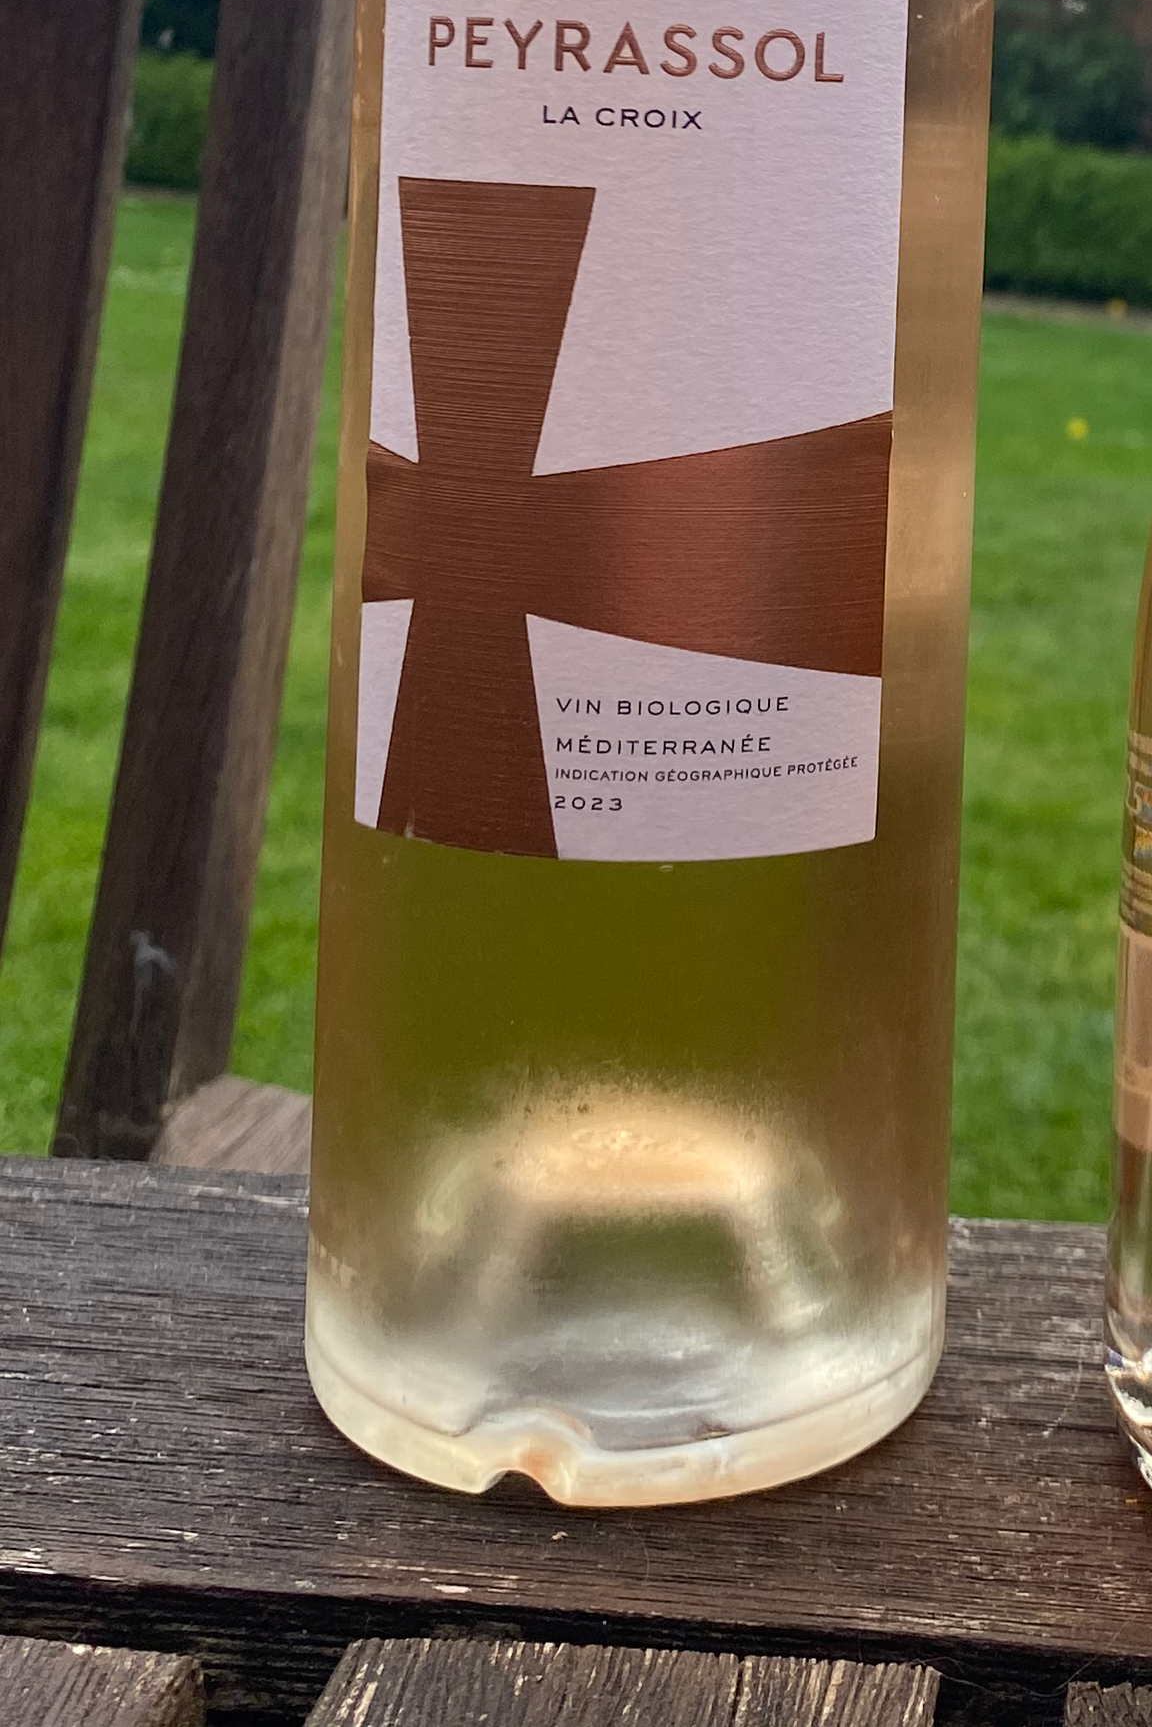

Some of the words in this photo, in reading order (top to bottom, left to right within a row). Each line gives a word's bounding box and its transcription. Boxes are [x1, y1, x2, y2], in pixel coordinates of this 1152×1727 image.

[428, 15, 845, 83] PEYRASSOL
[542, 105, 581, 125] LA
[595, 107, 703, 130] CROIX
[555, 698, 602, 715] VIN
[617, 696, 790, 716] BIOLOGIQUE
[555, 734, 772, 756] MÉDITERRANÉE
[554, 768, 649, 783] INDICATION
[655, 765, 782, 783] GÉOGRAPHIQUE
[787, 756, 859, 776] PROTÉGÉE
[553, 795, 624, 812] 2023
